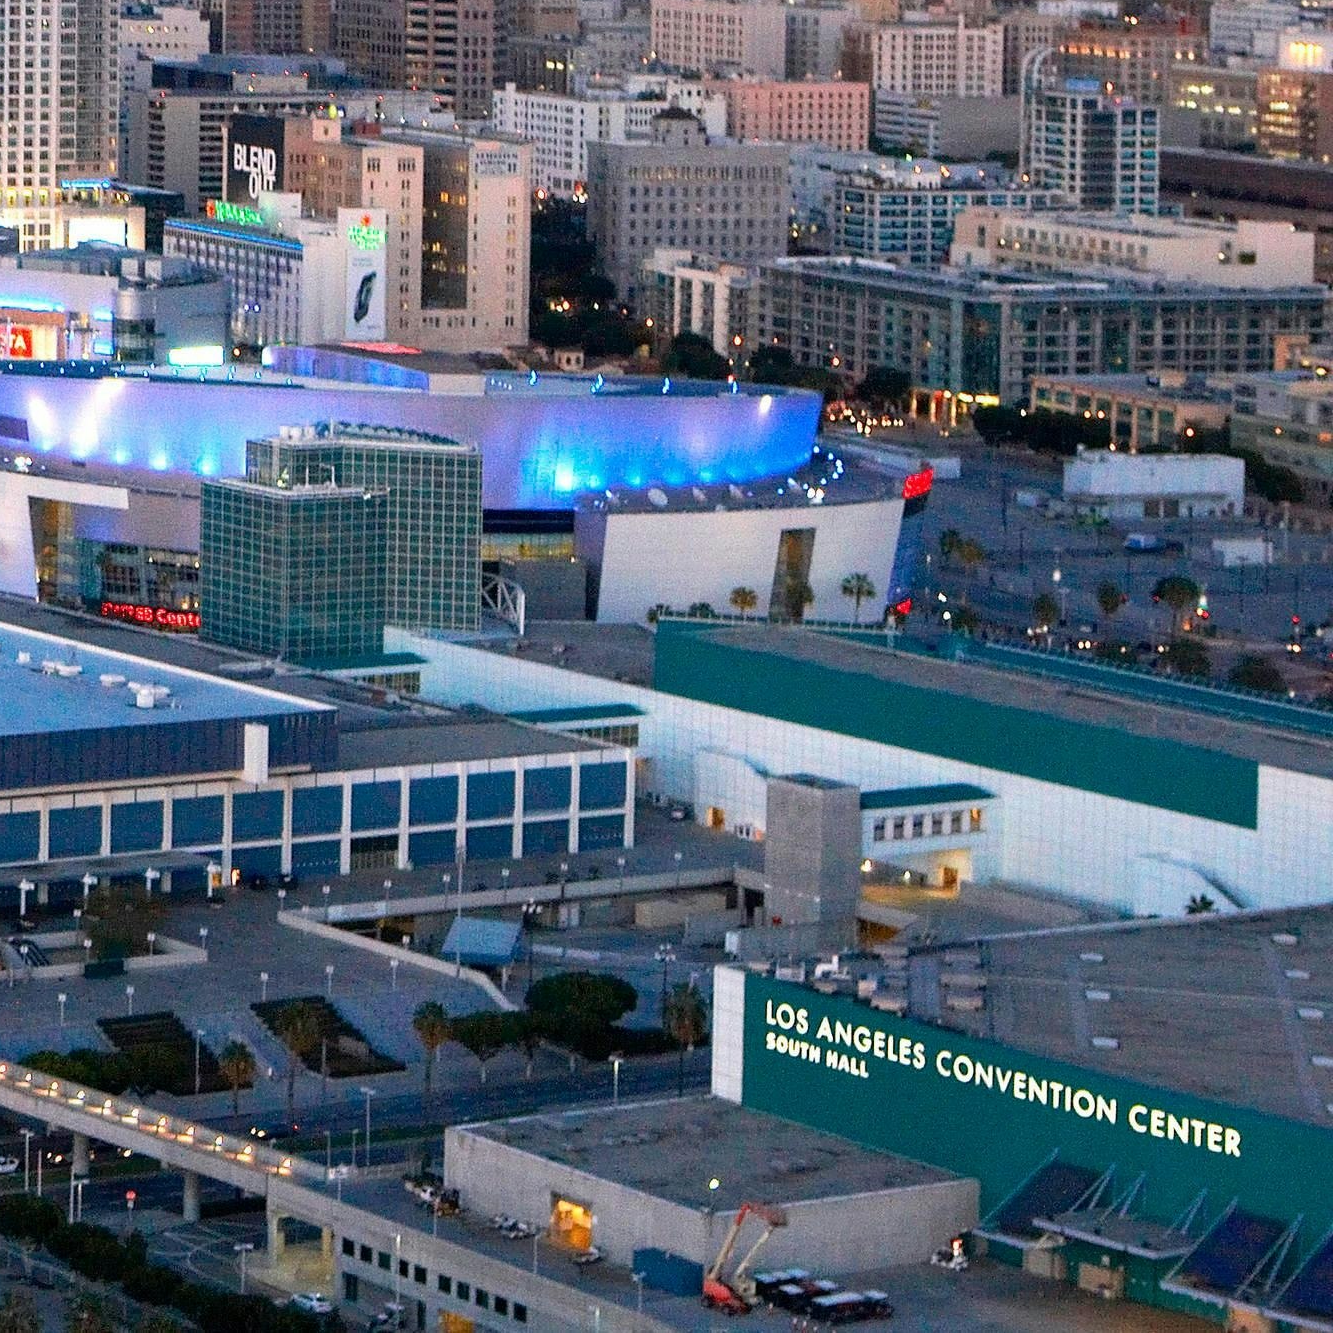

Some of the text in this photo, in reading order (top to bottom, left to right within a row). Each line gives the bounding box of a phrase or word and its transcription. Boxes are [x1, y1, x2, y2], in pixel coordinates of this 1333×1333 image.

[234, 143, 277, 176] BLEND
[249, 173, 277, 200] OUT
[765, 1031, 870, 1079] SOUTH HALL
[765, 999, 1243, 1159] LOS ANGELES CONVENTION CENTER
